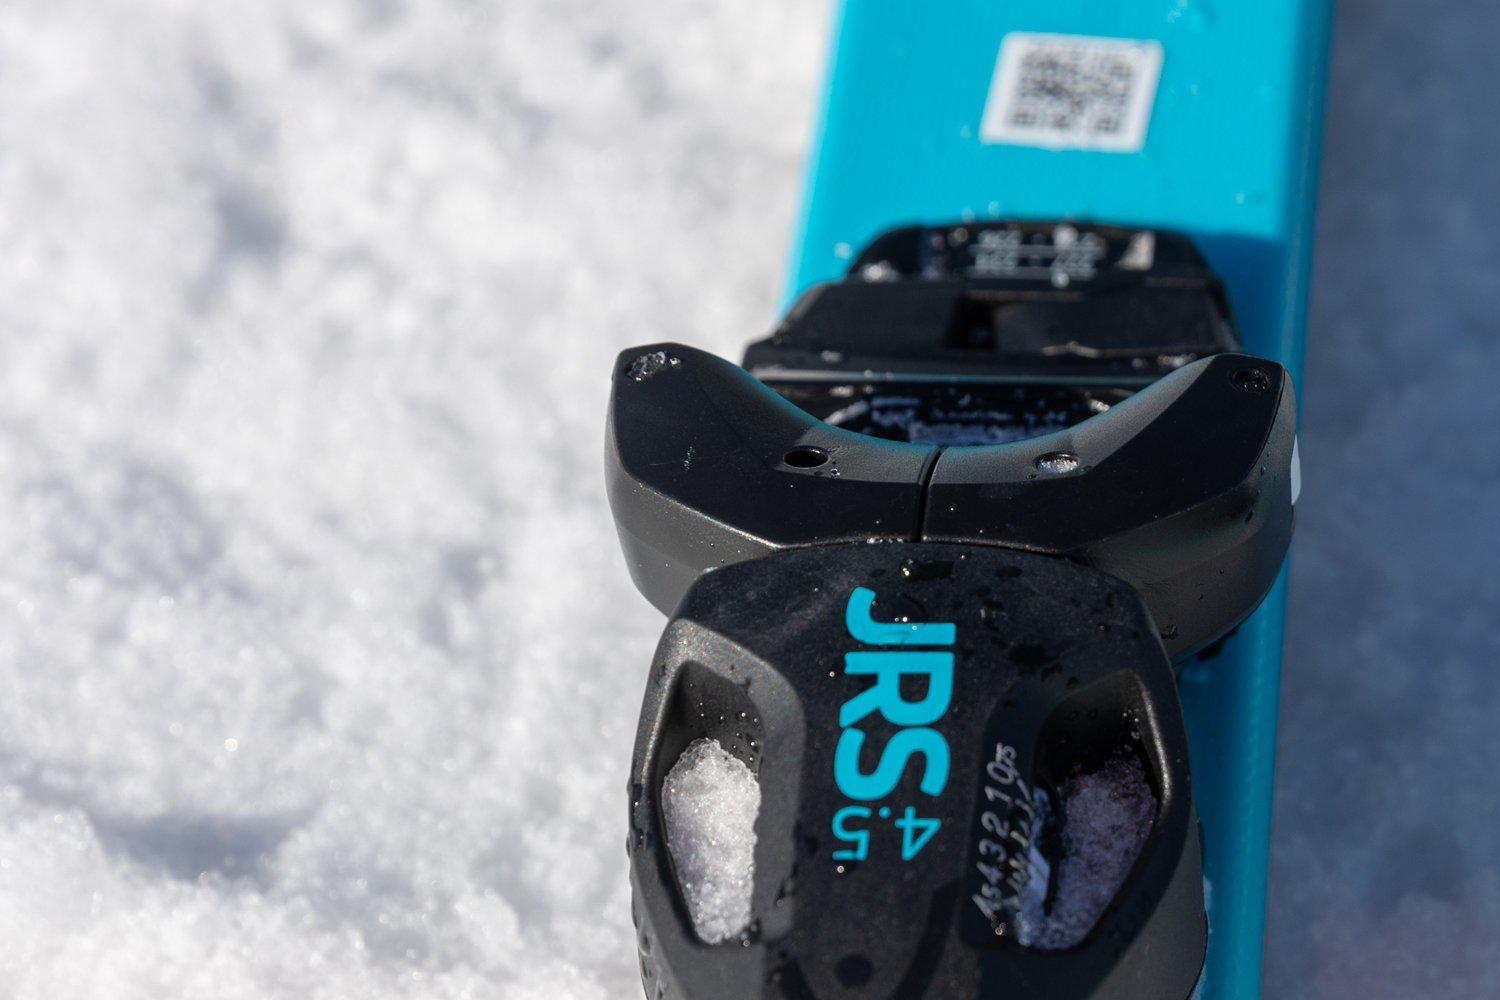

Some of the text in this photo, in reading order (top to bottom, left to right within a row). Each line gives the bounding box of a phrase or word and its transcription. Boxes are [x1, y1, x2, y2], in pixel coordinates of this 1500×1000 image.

[834, 586, 957, 800] JRS
[832, 806, 942, 860] 4.5
[981, 811, 1010, 839] 2
